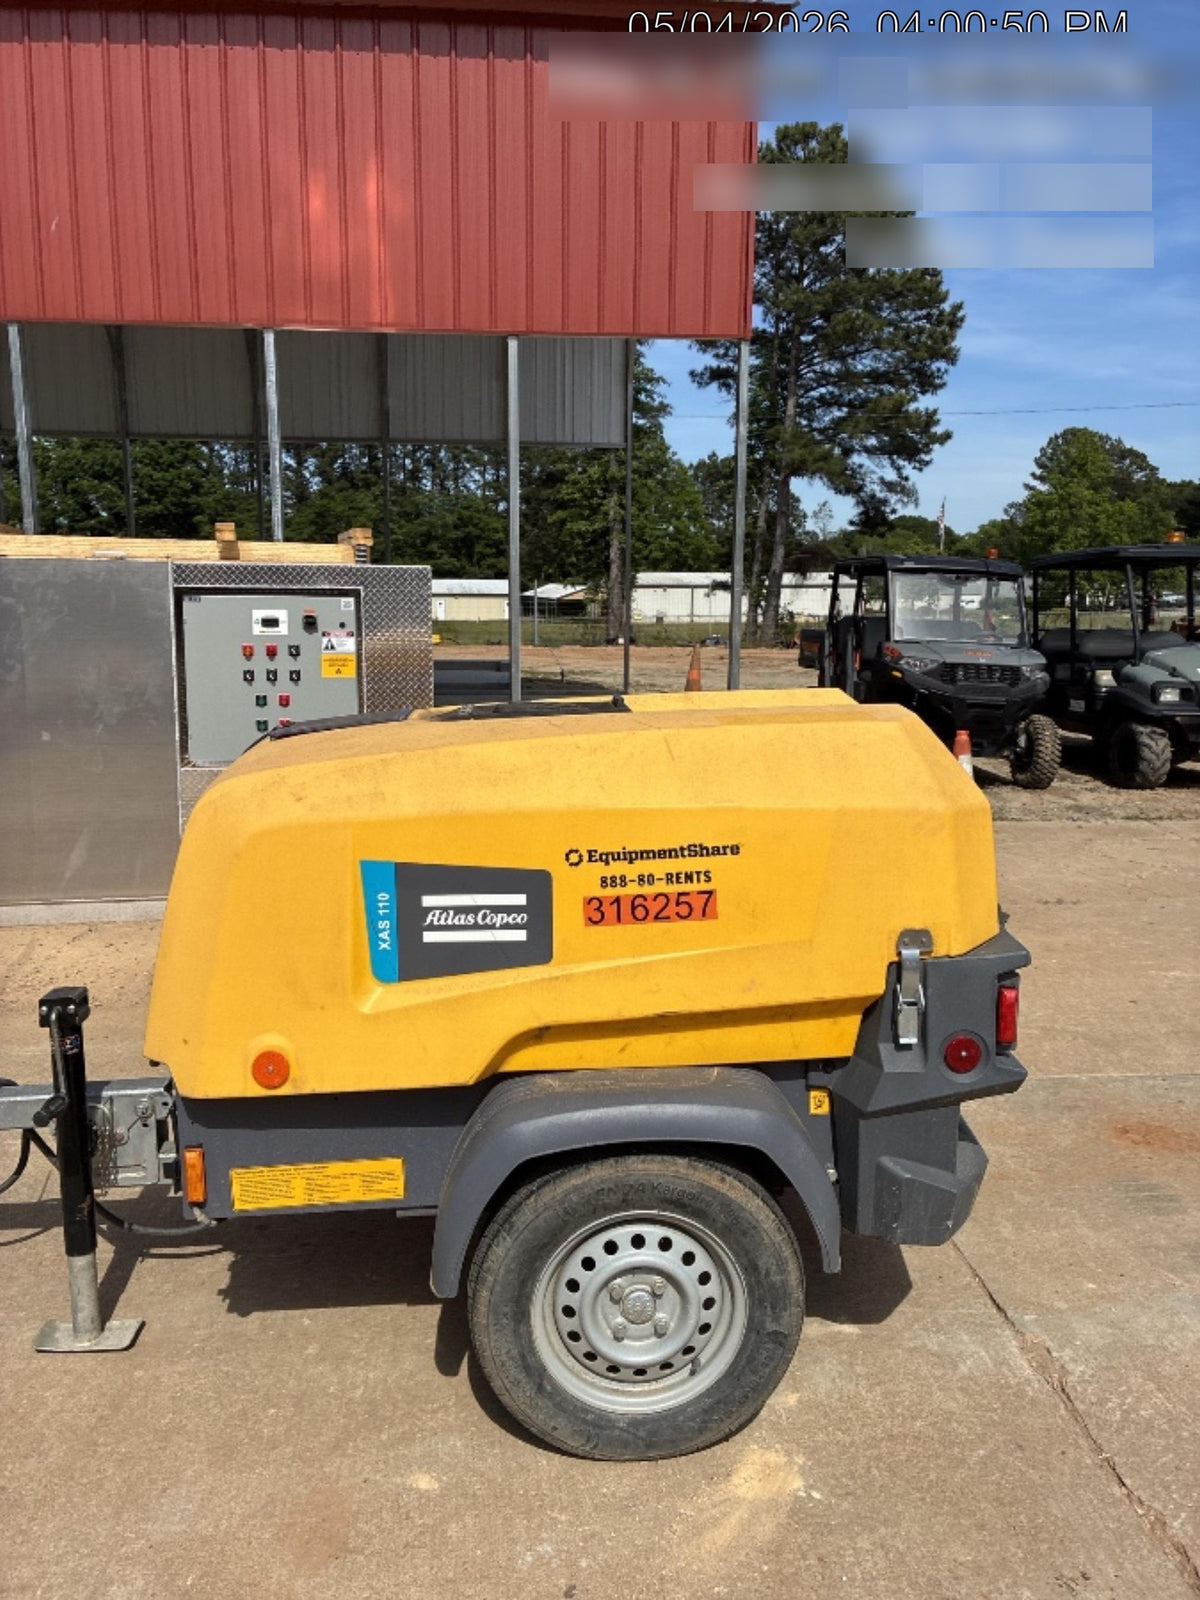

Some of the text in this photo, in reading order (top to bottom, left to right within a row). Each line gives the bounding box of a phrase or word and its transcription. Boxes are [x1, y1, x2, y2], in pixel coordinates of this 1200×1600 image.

[586, 843, 741, 867] EquipmentShare
[600, 870, 712, 889] 888-80-RENTS
[423, 909, 529, 928] Atlas Copco
[586, 890, 714, 925] 316257
[377, 892, 391, 950] XAS 110
